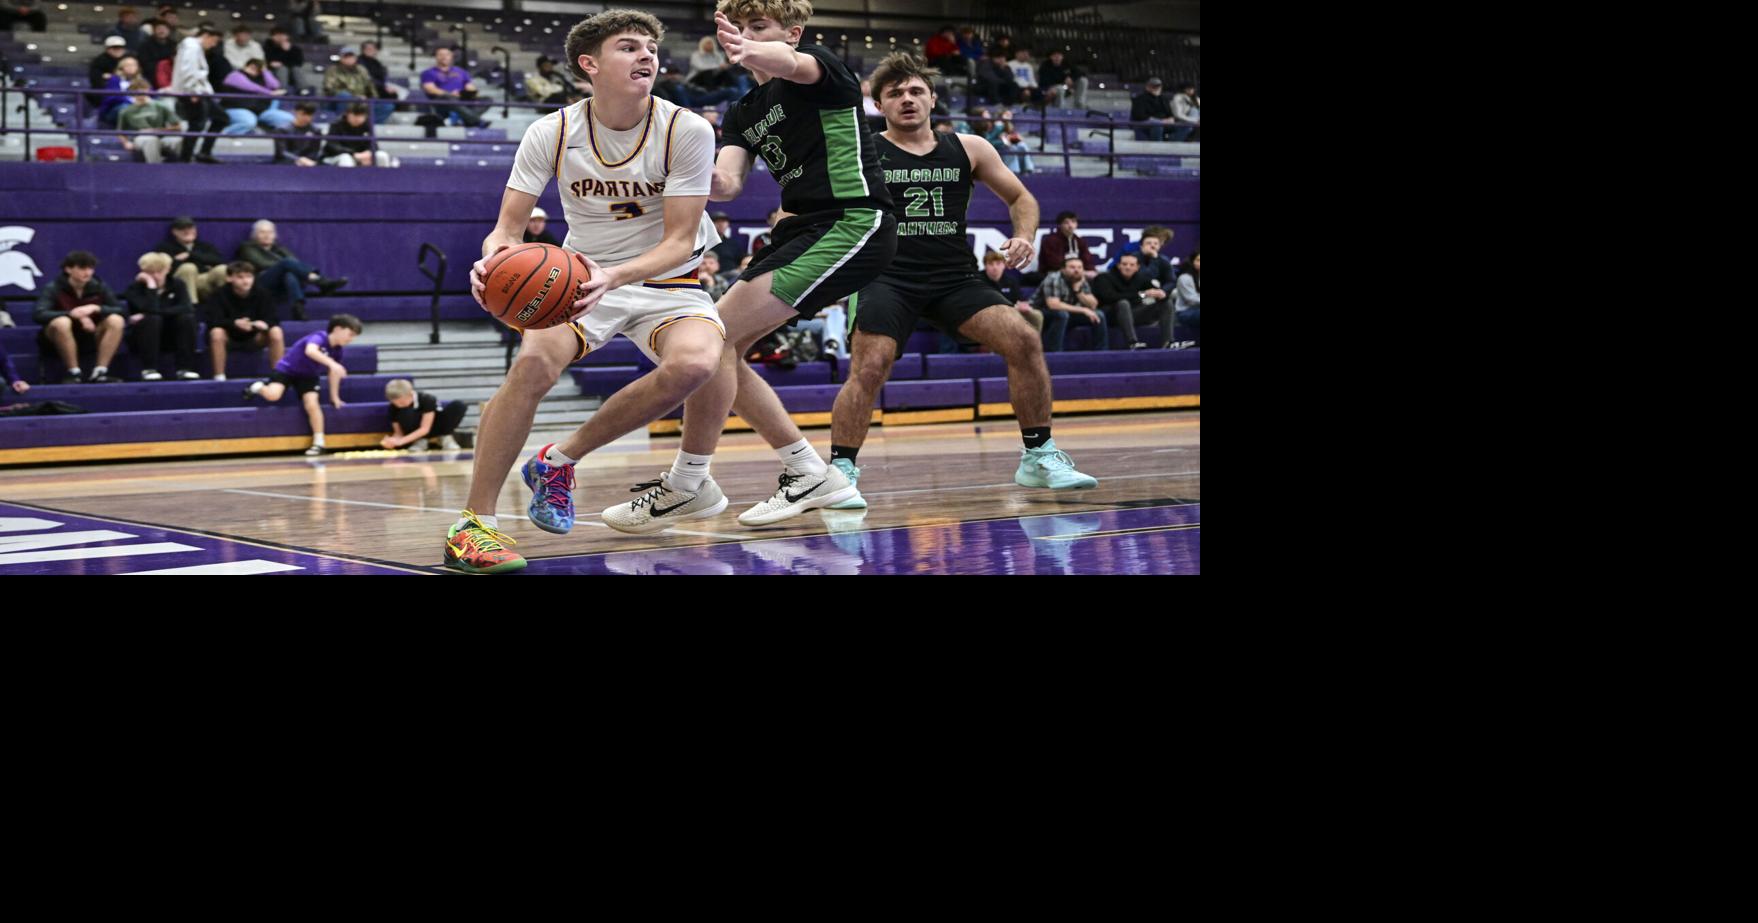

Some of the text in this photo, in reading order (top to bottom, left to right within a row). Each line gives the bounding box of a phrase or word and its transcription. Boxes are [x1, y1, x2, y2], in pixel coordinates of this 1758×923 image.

[883, 167, 961, 184] BELGRADE
[903, 186, 945, 217] 21
[896, 221, 959, 236] ANTHERS
